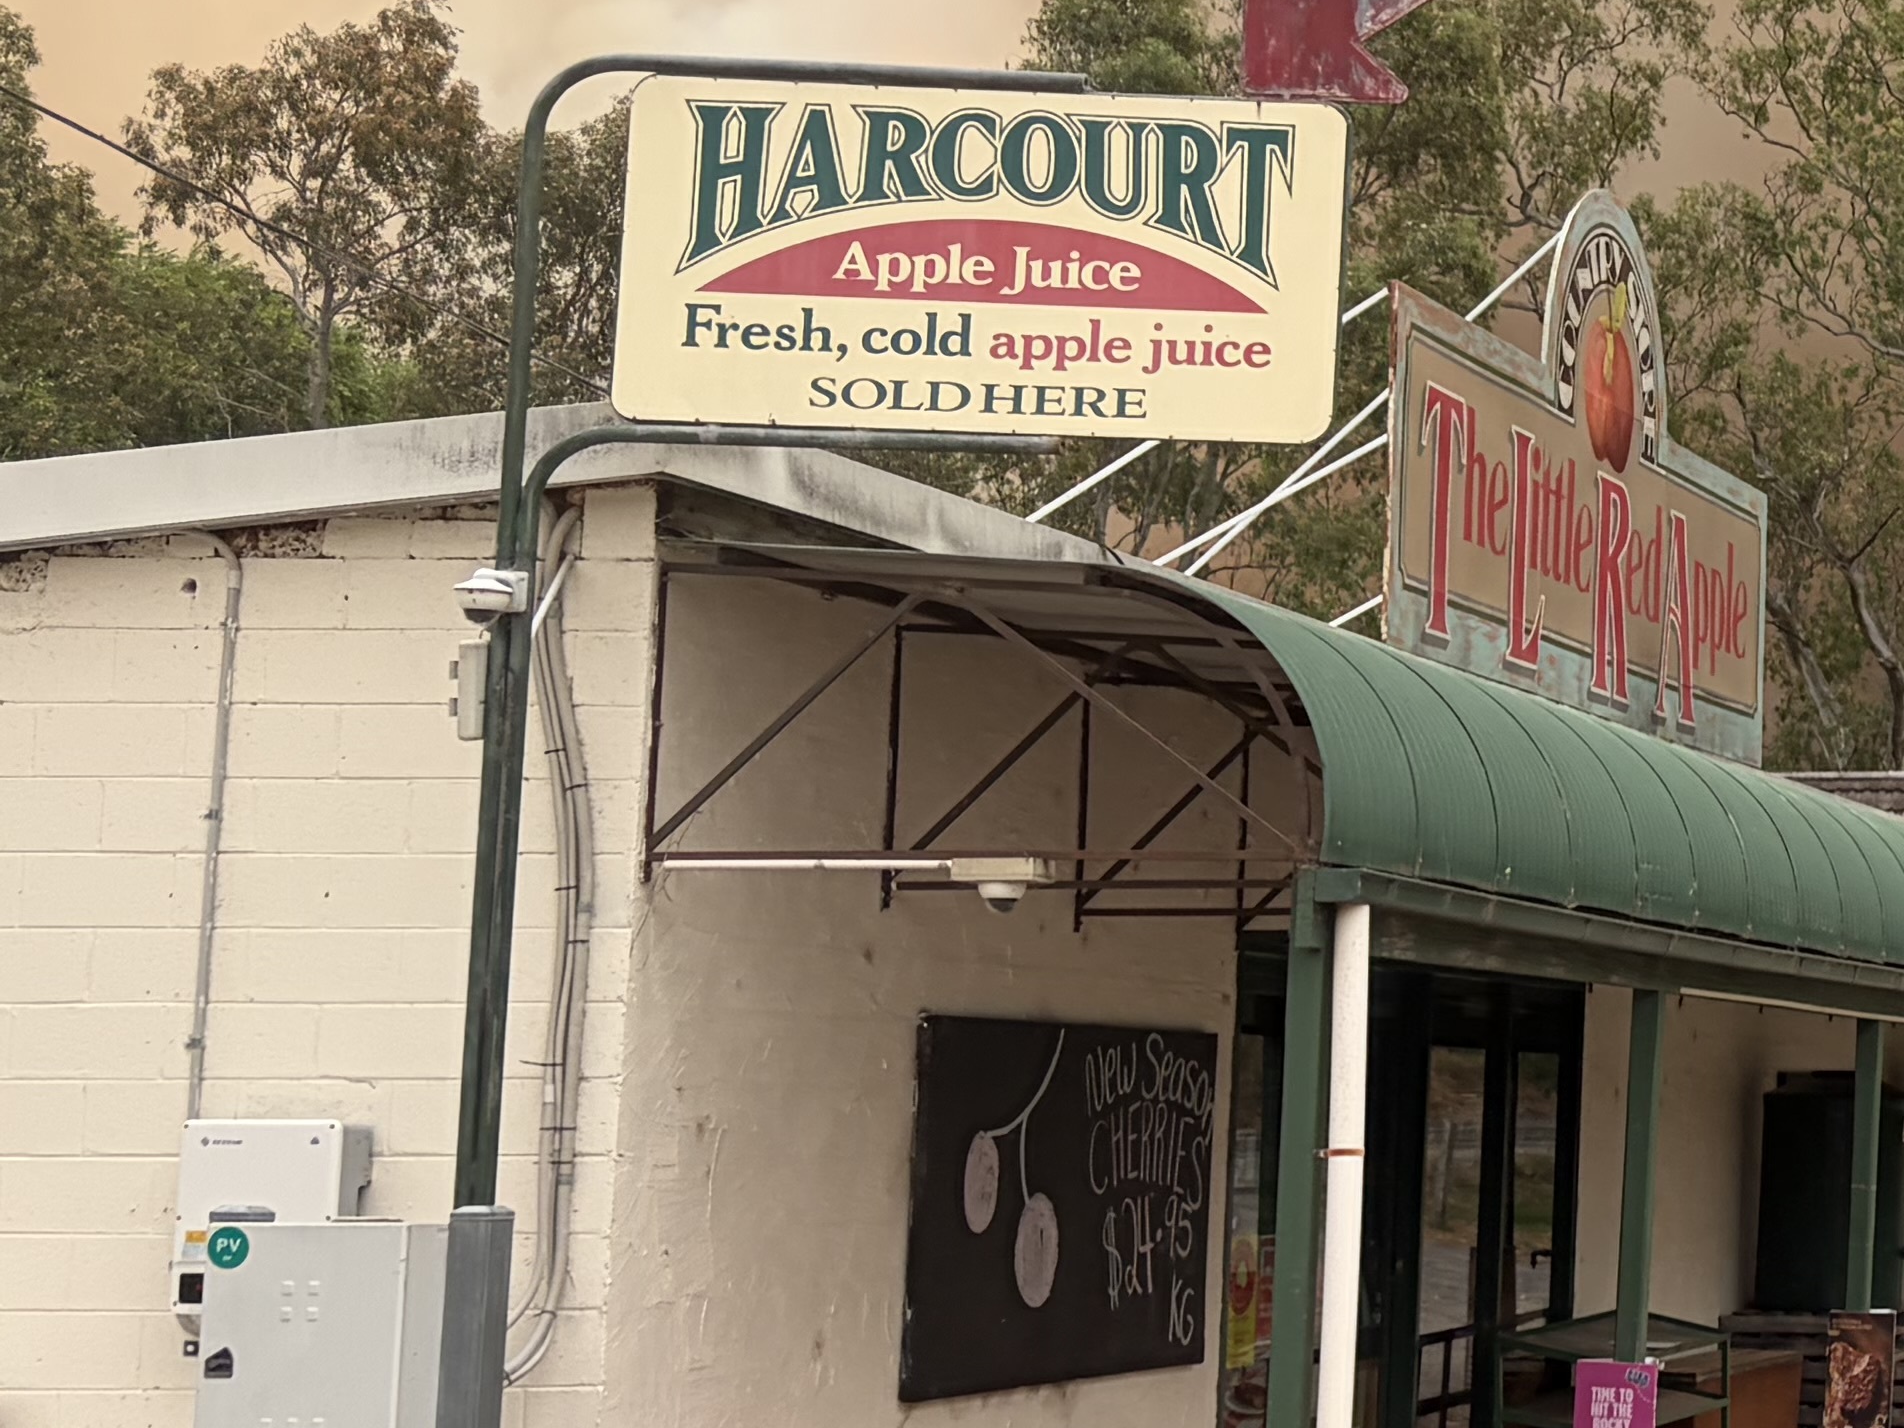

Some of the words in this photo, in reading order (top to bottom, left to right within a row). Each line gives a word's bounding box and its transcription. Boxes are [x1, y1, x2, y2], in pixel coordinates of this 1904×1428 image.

[674, 99, 1295, 291] HARCOURT
[833, 241, 995, 291] Apple
[1000, 246, 1141, 295] Juice
[681, 303, 848, 362] Fresh,
[861, 312, 972, 358] cold
[990, 319, 1132, 371] apple
[1143, 324, 1272, 374] juice
[1558, 236, 1625, 410] COUNTRY
[808, 378, 970, 411] SOLD
[979, 384, 1147, 419] HERE
[1422, 380, 1508, 642] The
[1505, 425, 1593, 668] Little
[1590, 472, 1662, 705] Red
[1655, 510, 1748, 726] Apple
[1085, 1042, 1137, 1117] New
[1141, 1032, 1214, 1146] Season
[1089, 1100, 1205, 1210] CHERRIES
[216, 1238, 242, 1253] PV
[1102, 1194, 1193, 1311] $24.95
[1168, 1270, 1195, 1346] KG
[1591, 1386, 1616, 1402] TIME
[1619, 1388, 1634, 1403] TO
[1612, 1403, 1633, 1418] THE
